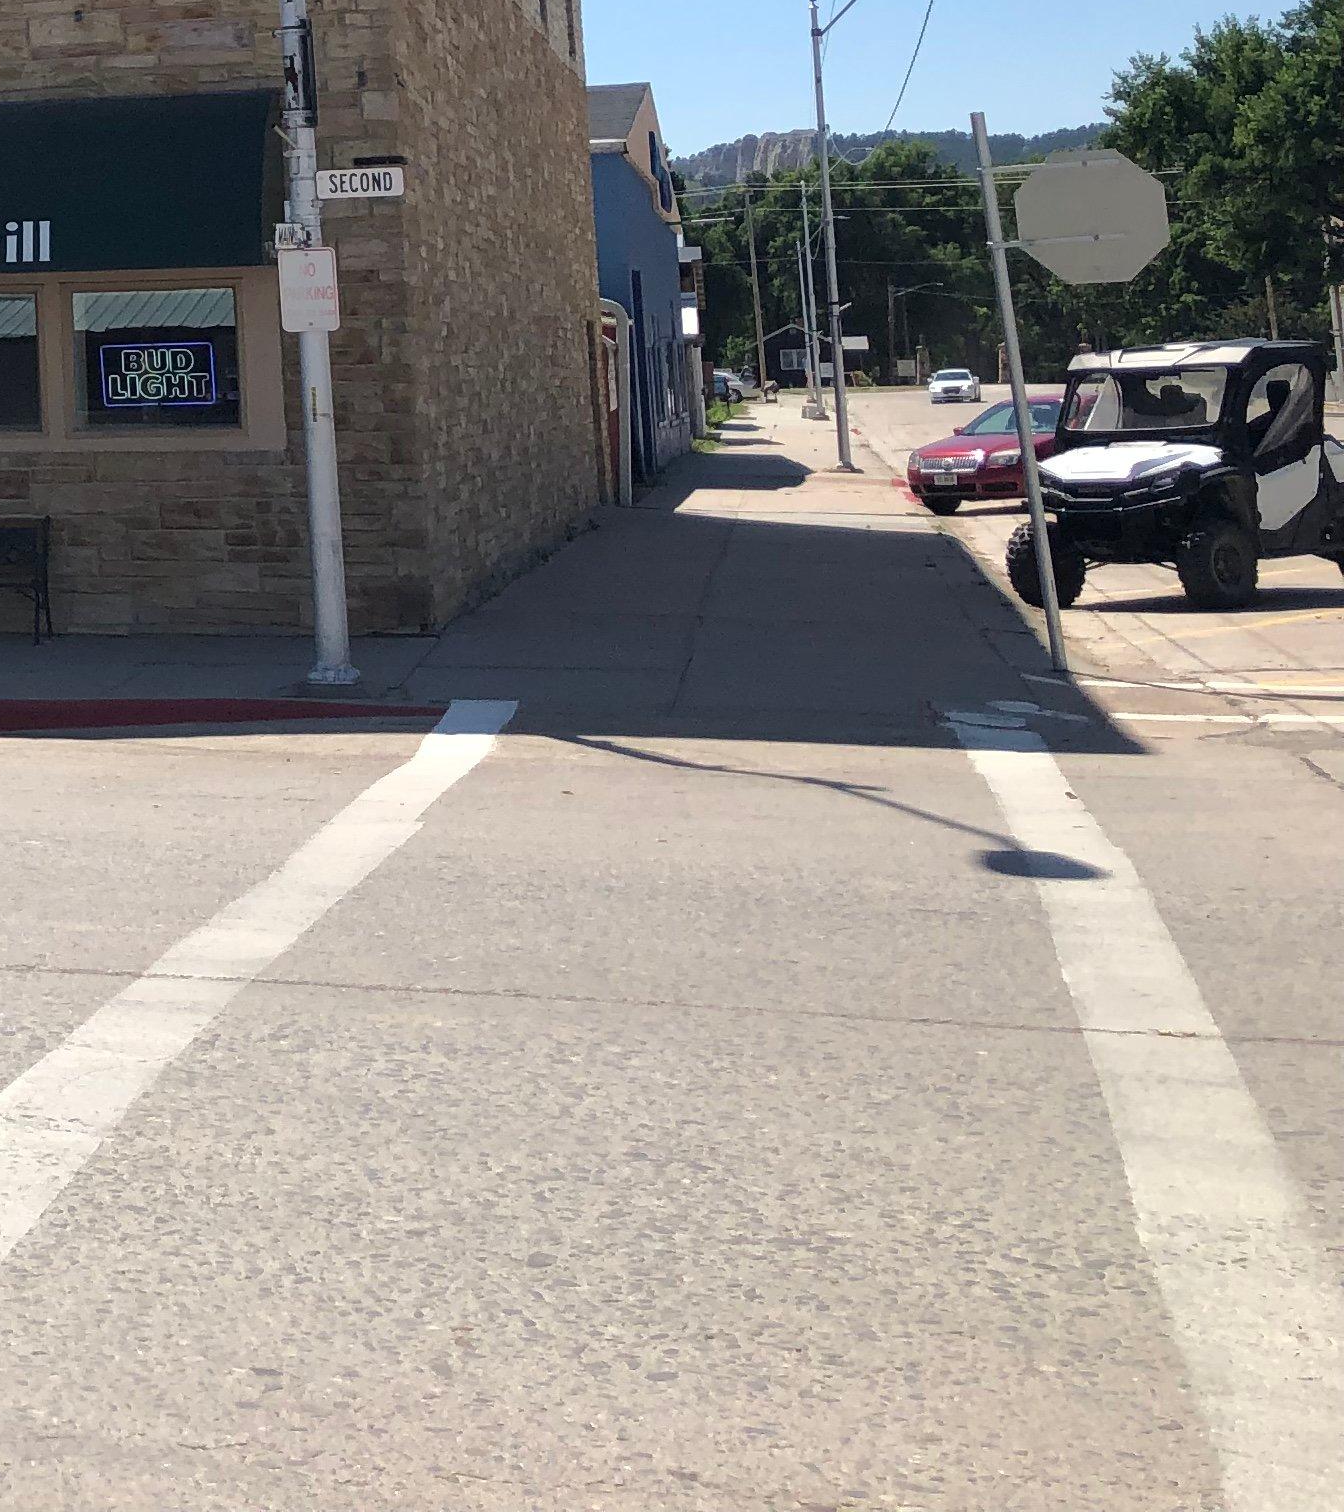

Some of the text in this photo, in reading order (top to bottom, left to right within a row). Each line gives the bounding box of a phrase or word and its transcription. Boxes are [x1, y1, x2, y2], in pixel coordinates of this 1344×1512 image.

[328, 171, 393, 194] SECOND
[121, 348, 194, 374] BUD
[108, 372, 210, 400] LIGHT
